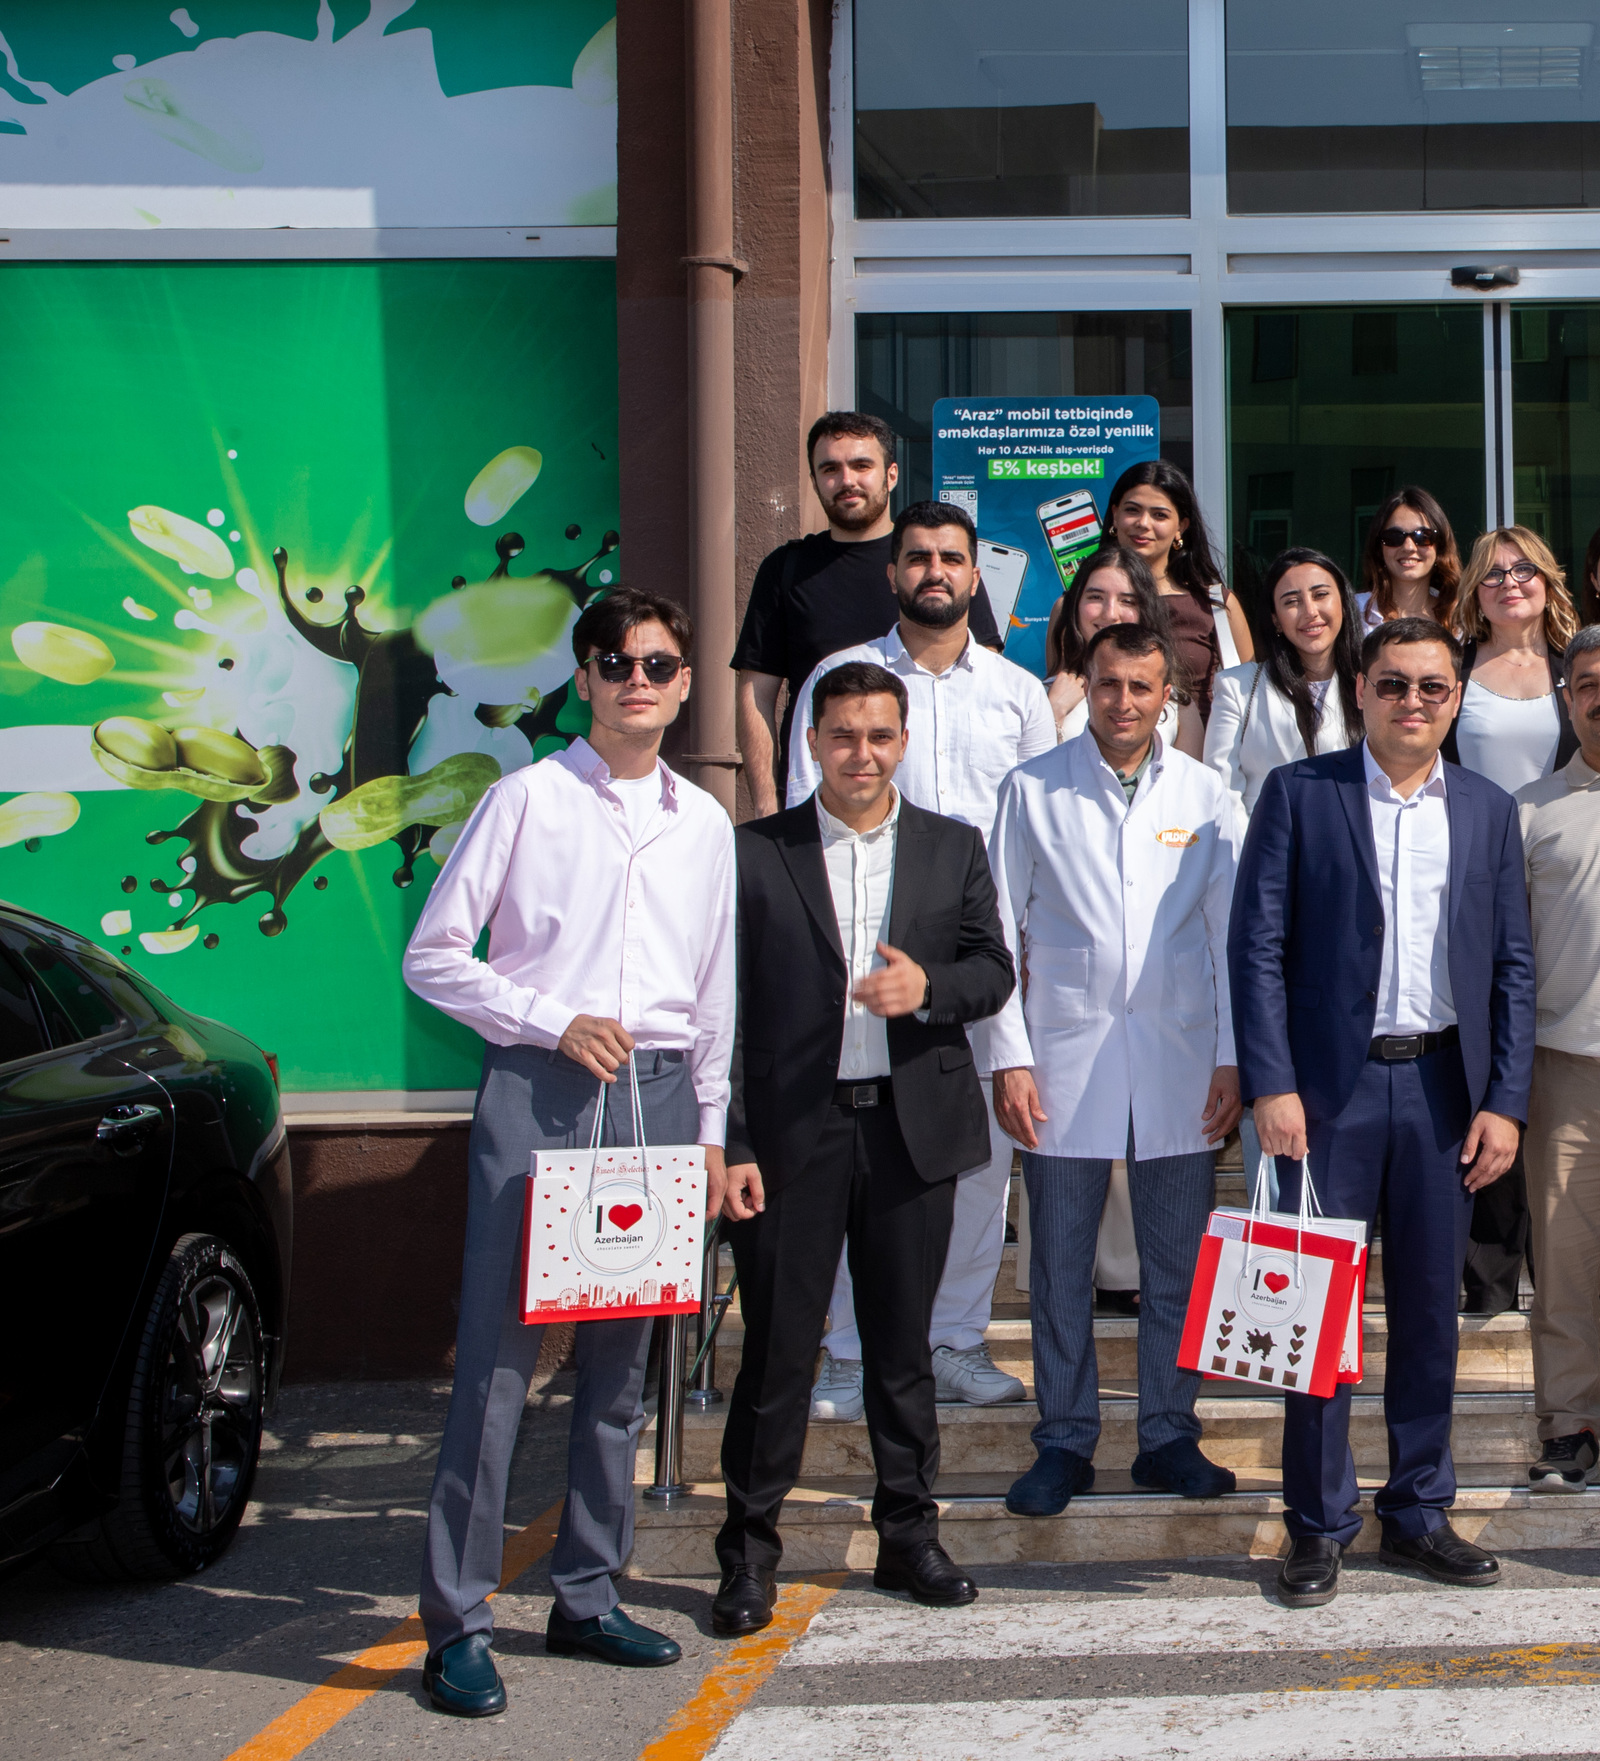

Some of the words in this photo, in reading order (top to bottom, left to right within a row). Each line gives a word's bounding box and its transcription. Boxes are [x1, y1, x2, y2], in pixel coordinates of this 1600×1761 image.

[954, 409, 1002, 421] “Araz”
[1008, 408, 1050, 420] mobil
[1055, 407, 1133, 422] tətbiqində
[938, 426, 1064, 440] əməkdaşlarımıza
[1069, 425, 1100, 437] özəl
[1105, 424, 1154, 439] yenilik
[978, 446, 996, 455] Hər
[999, 446, 1011, 454] 10
[1014, 446, 1052, 454] AZN-lik
[1055, 446, 1114, 456] alış-verişdə
[992, 461, 1020, 476] 5%
[1026, 460, 1100, 478] keşbek!
[596, 1205, 603, 1233] I
[594, 1234, 643, 1244] Azerbaijan
[1253, 1269, 1261, 1291] I
[1251, 1293, 1287, 1305] Azerbaijan
